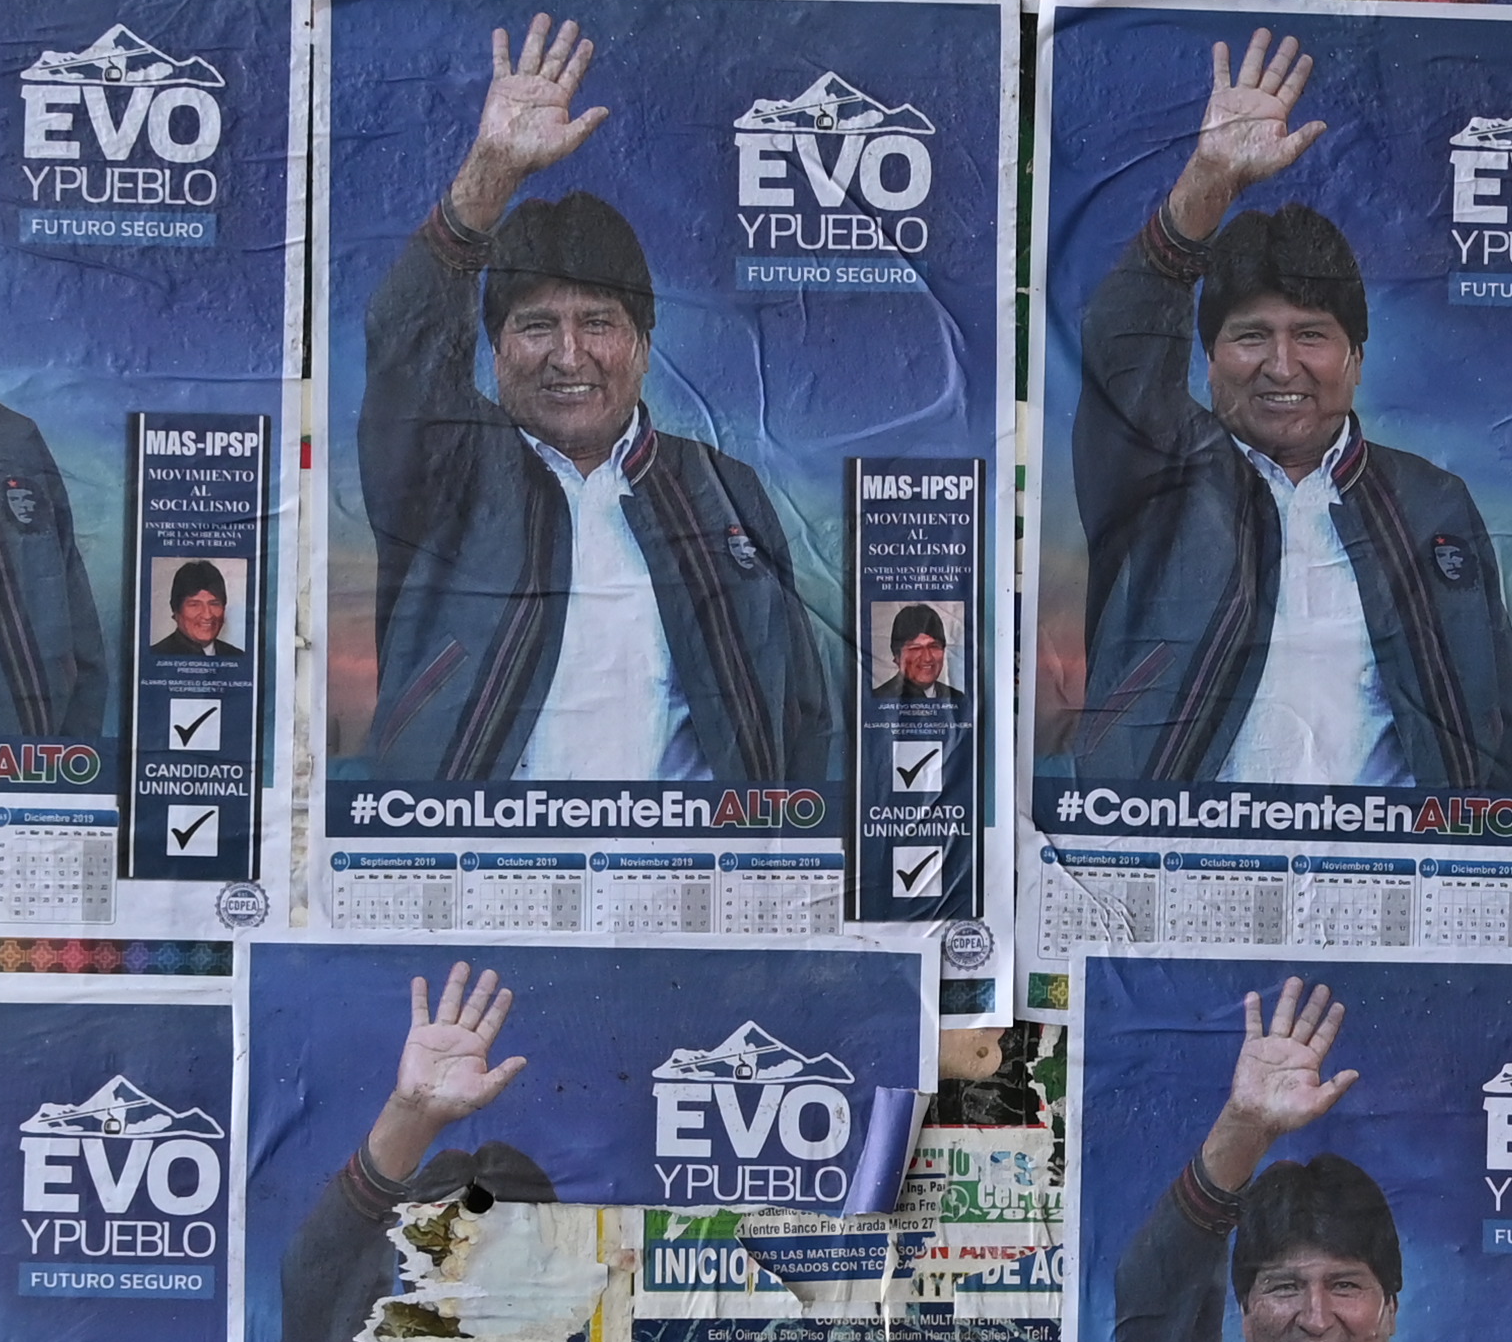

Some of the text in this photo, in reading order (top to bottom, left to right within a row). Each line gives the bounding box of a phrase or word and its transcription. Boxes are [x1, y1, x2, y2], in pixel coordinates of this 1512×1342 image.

[20, 84, 221, 163] EVO
[734, 133, 931, 209] EVO
[863, 475, 973, 500] MAS-IPSP
[350, 789, 825, 829] #ConLaFrenteEnALTO
[653, 1083, 849, 1159] EVO
[20, 1137, 219, 1215] EVO
